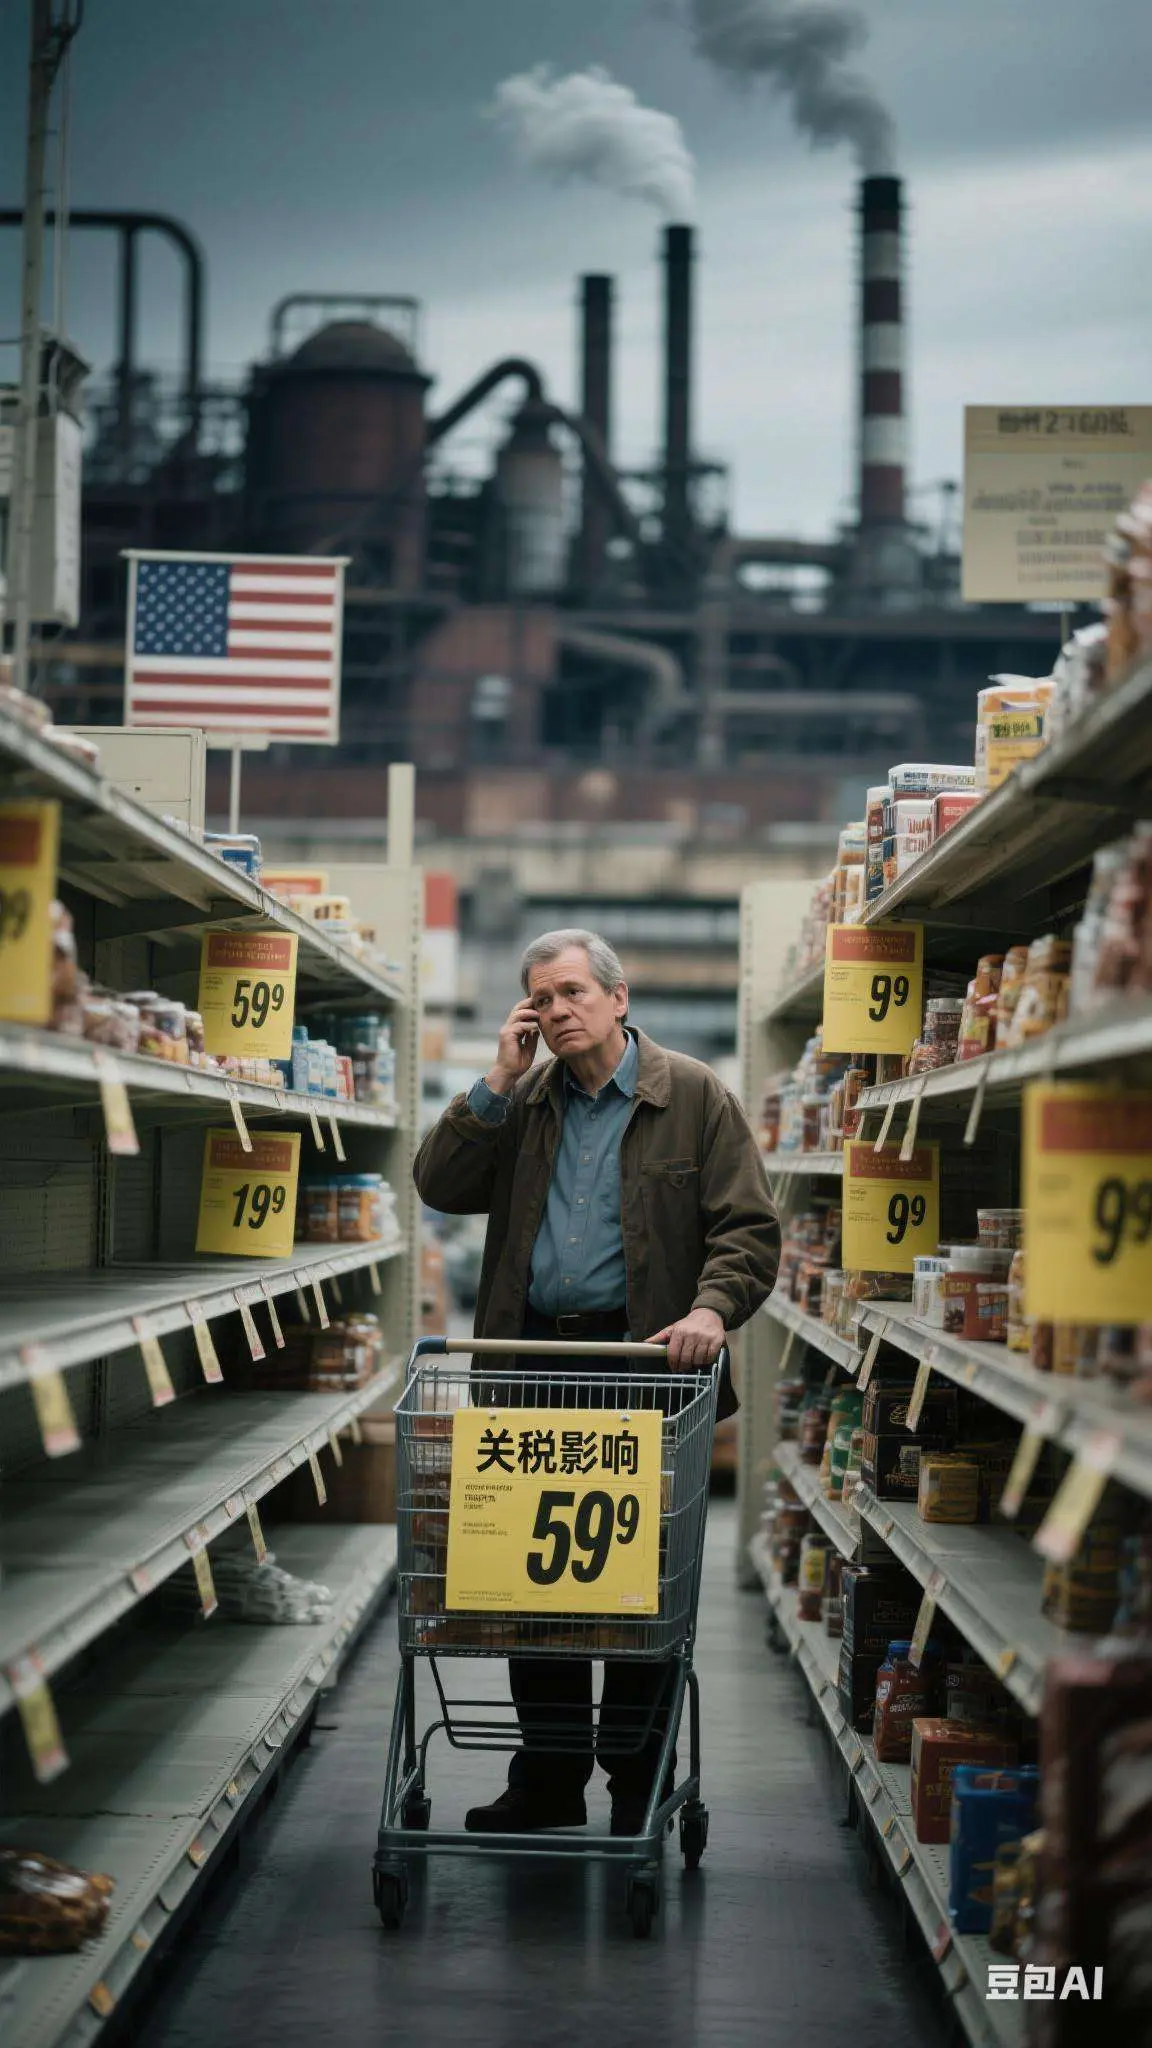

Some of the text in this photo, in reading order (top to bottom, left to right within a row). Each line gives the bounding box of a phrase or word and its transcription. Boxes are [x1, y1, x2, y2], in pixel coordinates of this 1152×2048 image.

[231, 979, 285, 1029] 599
[868, 974, 910, 1023] 99
[232, 1183, 286, 1230] 199
[886, 1193, 926, 1245] 99
[476, 1428, 639, 1476] 关税影响
[526, 1490, 641, 1586] 599
